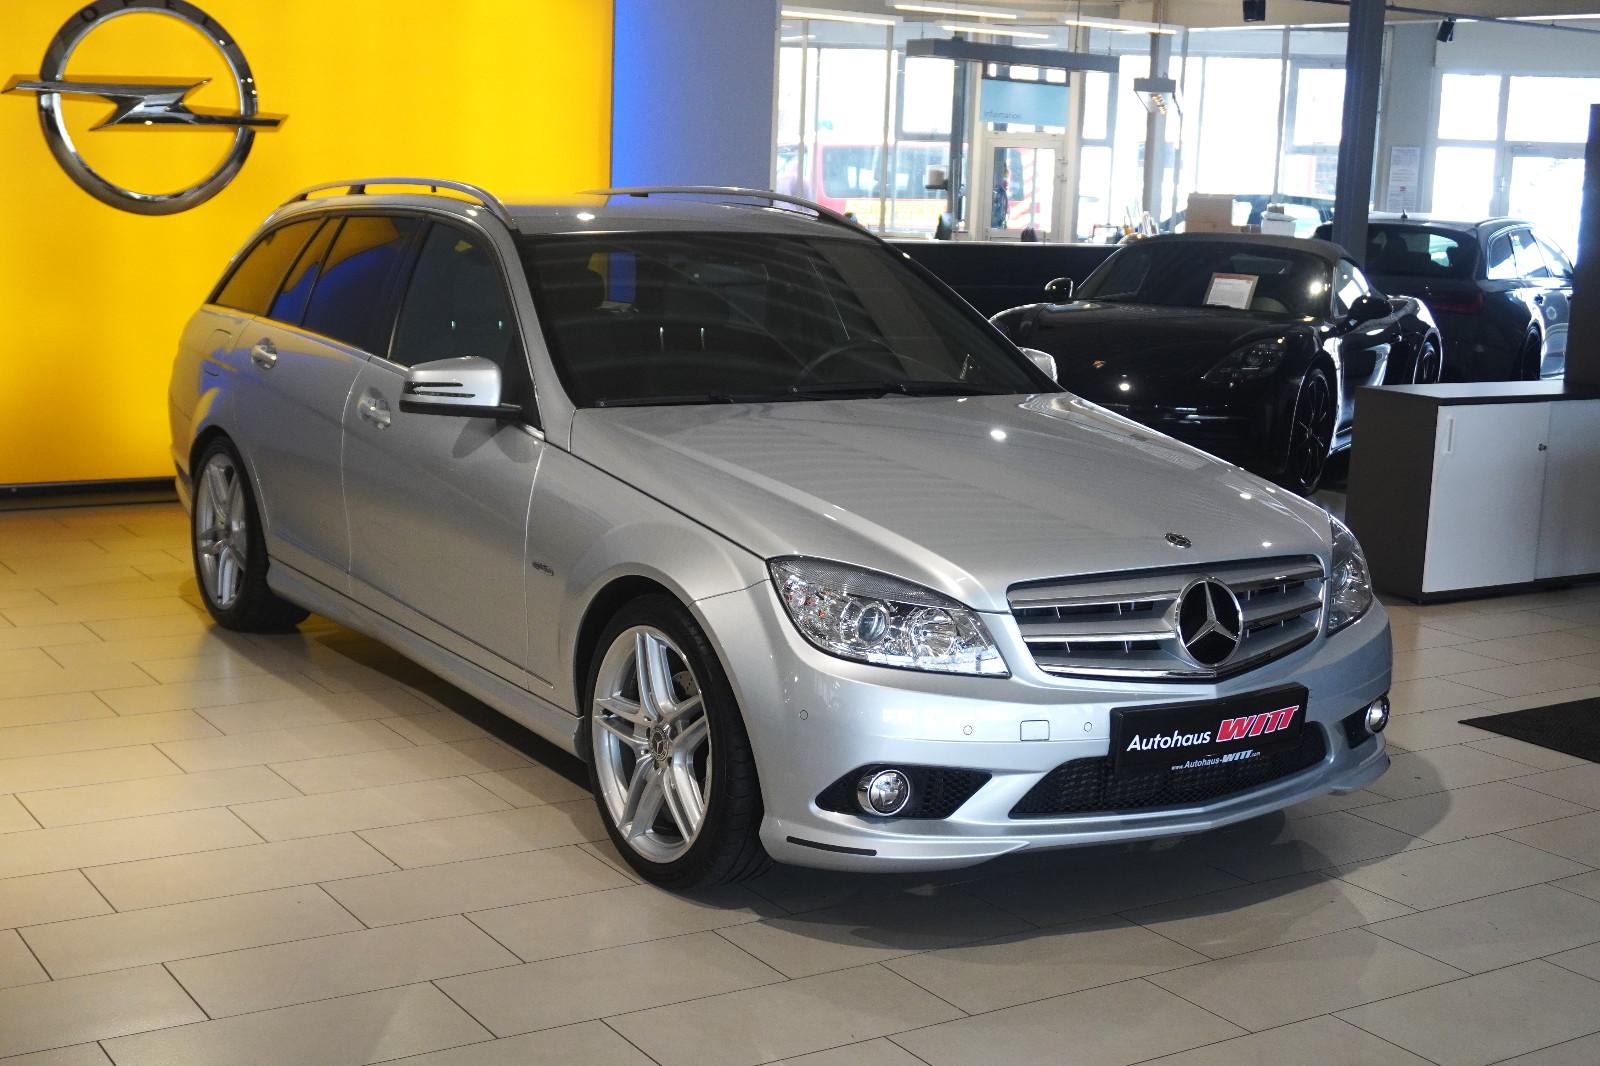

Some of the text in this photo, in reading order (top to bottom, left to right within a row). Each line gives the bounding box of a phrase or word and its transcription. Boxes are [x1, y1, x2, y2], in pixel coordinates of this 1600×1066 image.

[1127, 705, 1299, 752] Autohaus WITT
[1171, 749, 1261, 771] www.Autohaus-WITT.com
